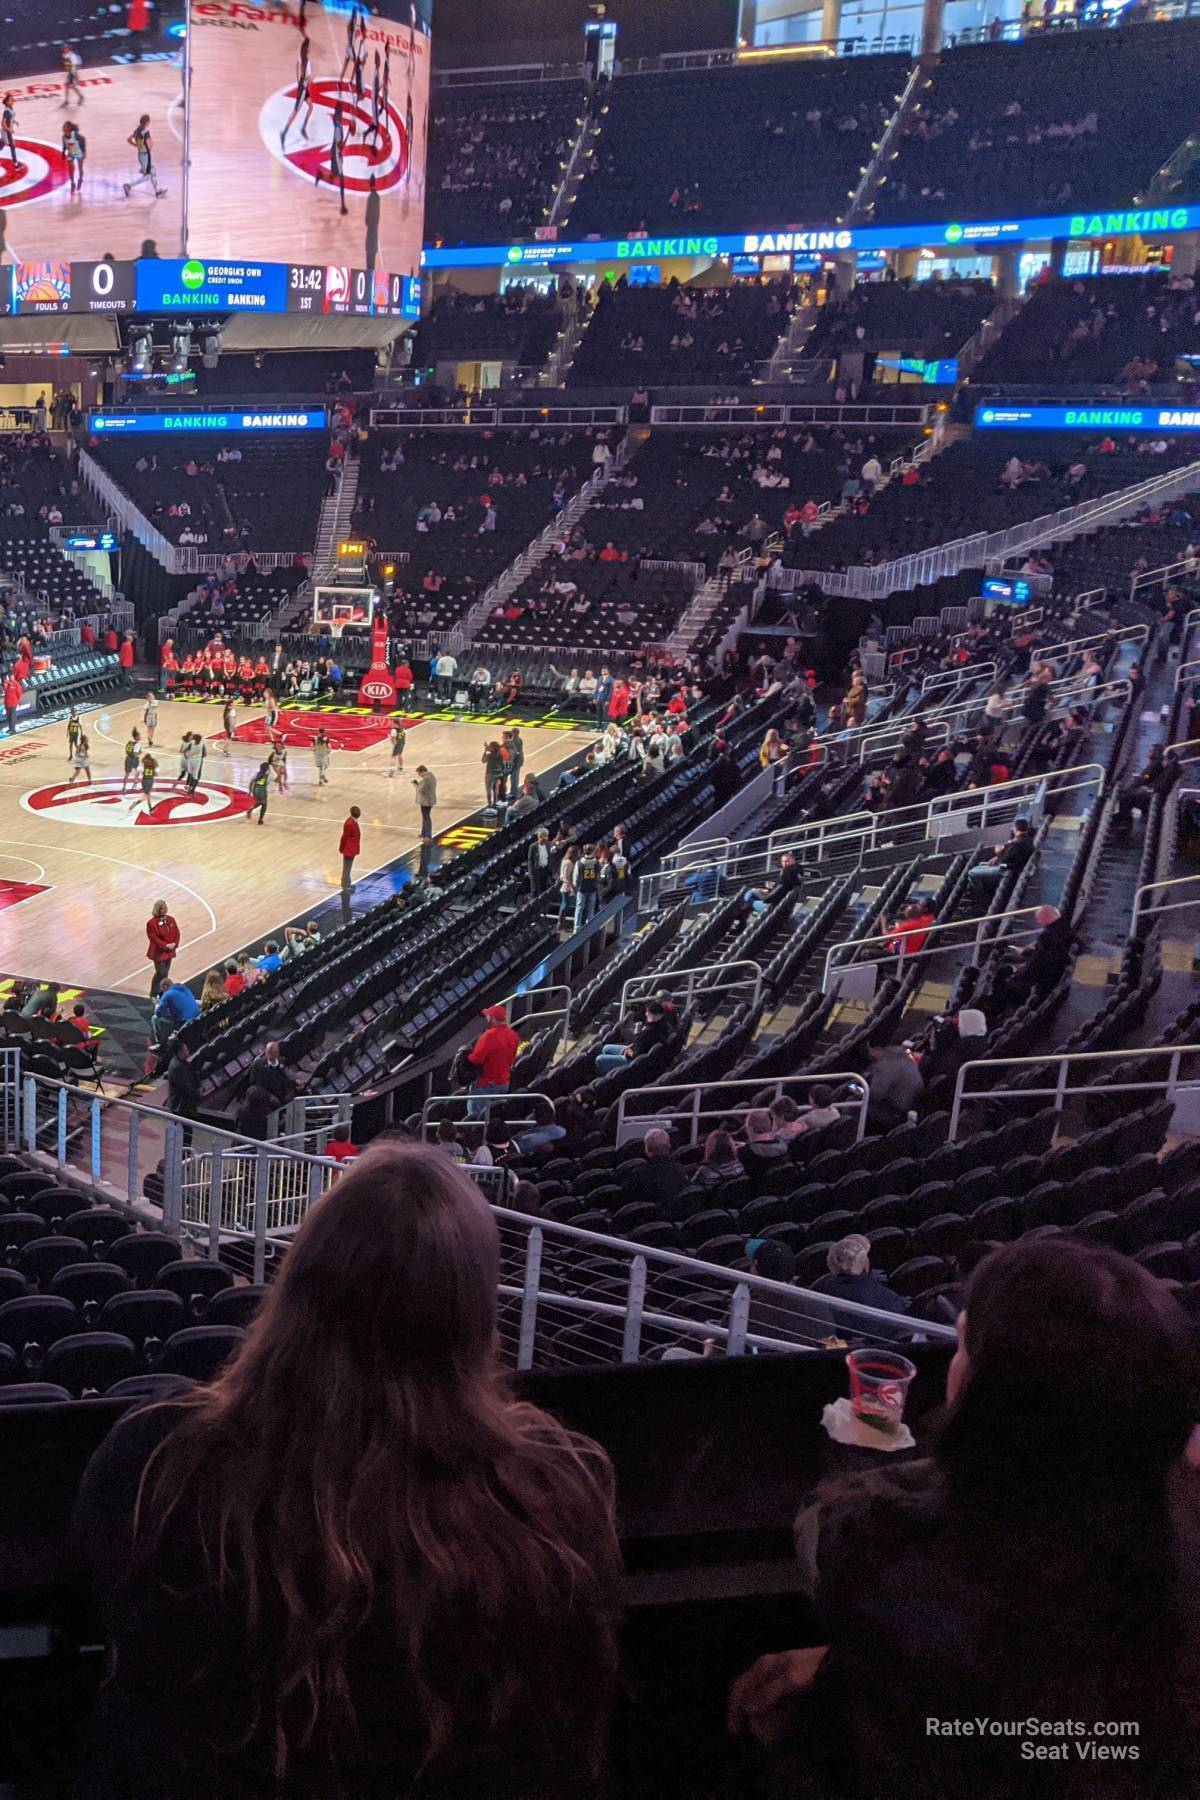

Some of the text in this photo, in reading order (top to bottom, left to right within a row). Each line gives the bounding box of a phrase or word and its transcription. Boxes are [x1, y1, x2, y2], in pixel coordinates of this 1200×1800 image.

[1070, 208, 1188, 236] BANKING
[617, 238, 718, 258] BANKING
[745, 231, 851, 252] BANKING
[208, 266, 262, 278] GEORGIA'S OWN
[92, 264, 114, 295] 0
[208, 276, 243, 285] CREDIT UNION
[290, 268, 322, 290] 31:42
[357, 272, 366, 300] 0
[393, 276, 400, 303] 0
[90, 300, 137, 309] TIMEOUTS 7
[162, 293, 220, 305] BANKING
[228, 293, 266, 306] BANKING
[300, 297, 312, 309] 1ST
[5, 304, 11, 312] 7
[35, 303, 68, 311] FOULS 0
[164, 417, 227, 428] BANKING
[242, 414, 308, 427] BANKING
[1065, 411, 1143, 425] BANKING
[367, 686, 389, 696] KIA
[388, 710, 584, 731] HAWKS
